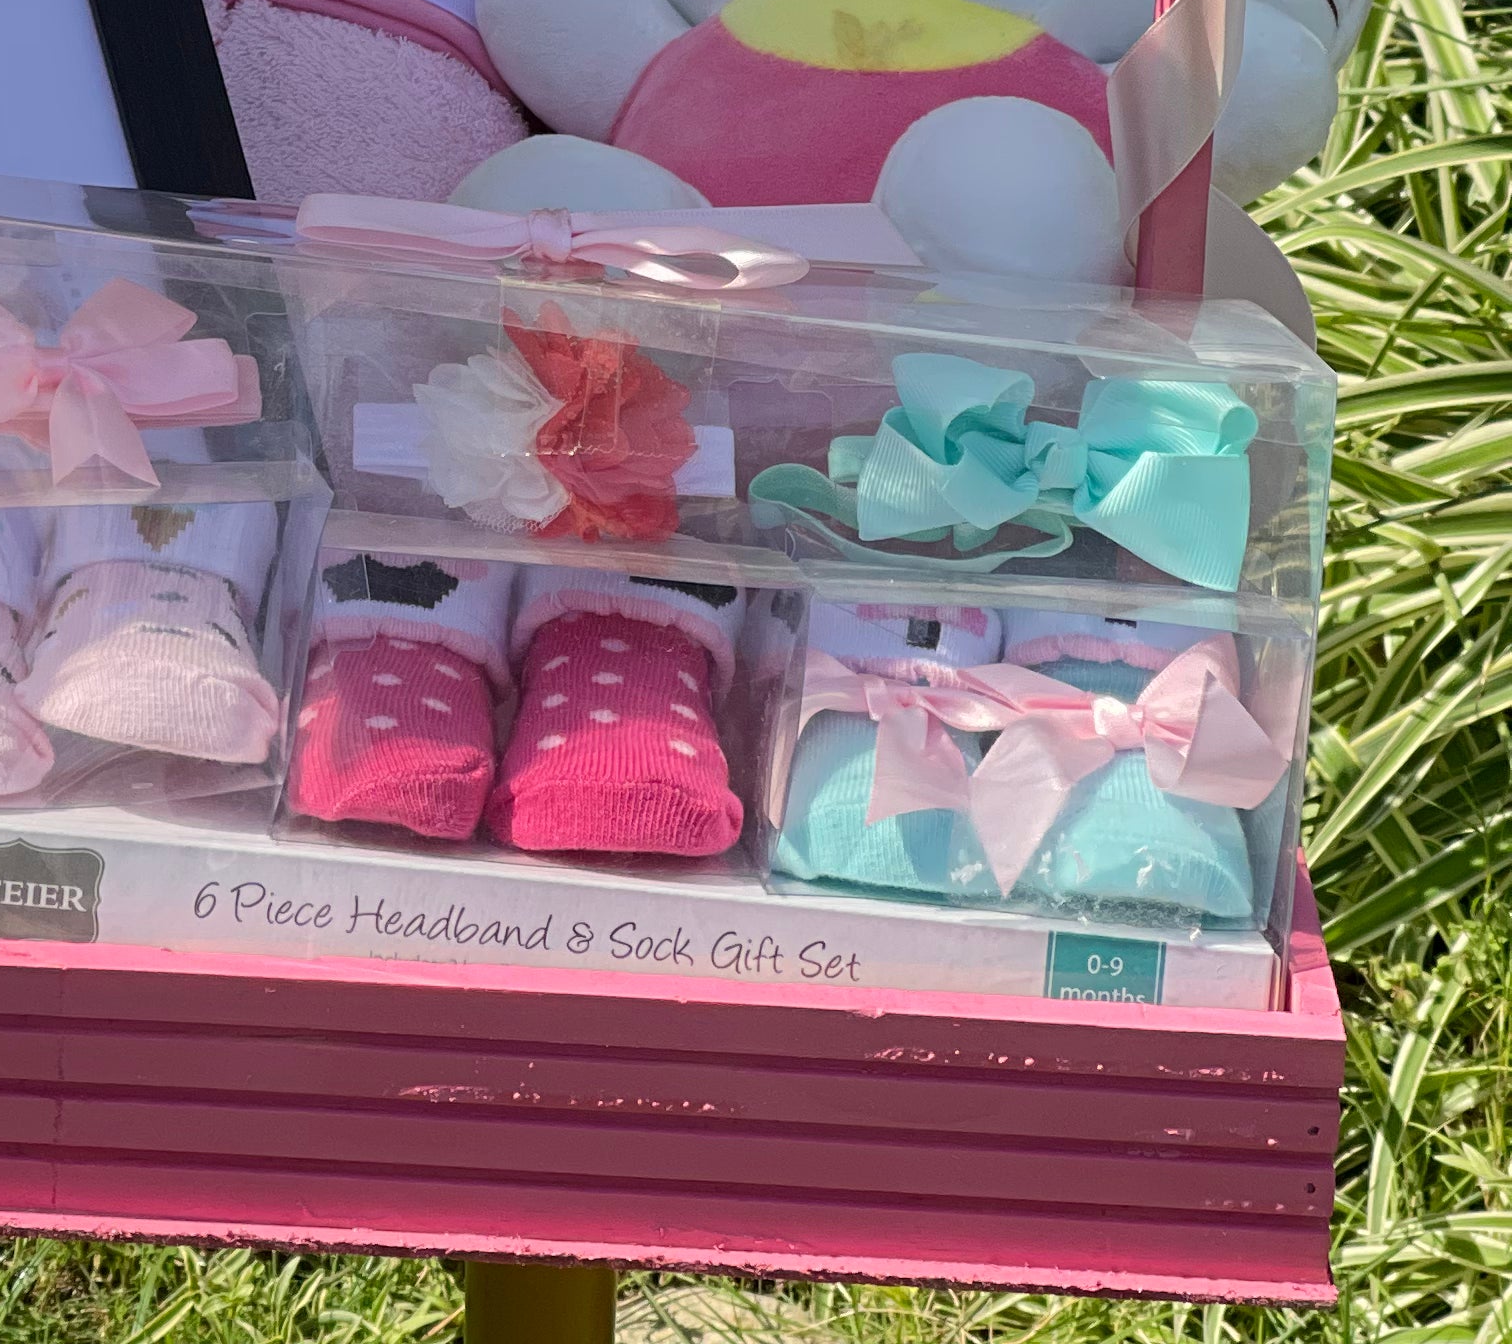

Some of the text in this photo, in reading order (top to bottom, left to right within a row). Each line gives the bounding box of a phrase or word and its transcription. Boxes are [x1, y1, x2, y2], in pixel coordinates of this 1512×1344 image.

[194, 881, 862, 983] 6 Piece Headband & Sock Gift Set
[1087, 954, 1124, 976] 0-9
[1059, 986, 1146, 1004] months
